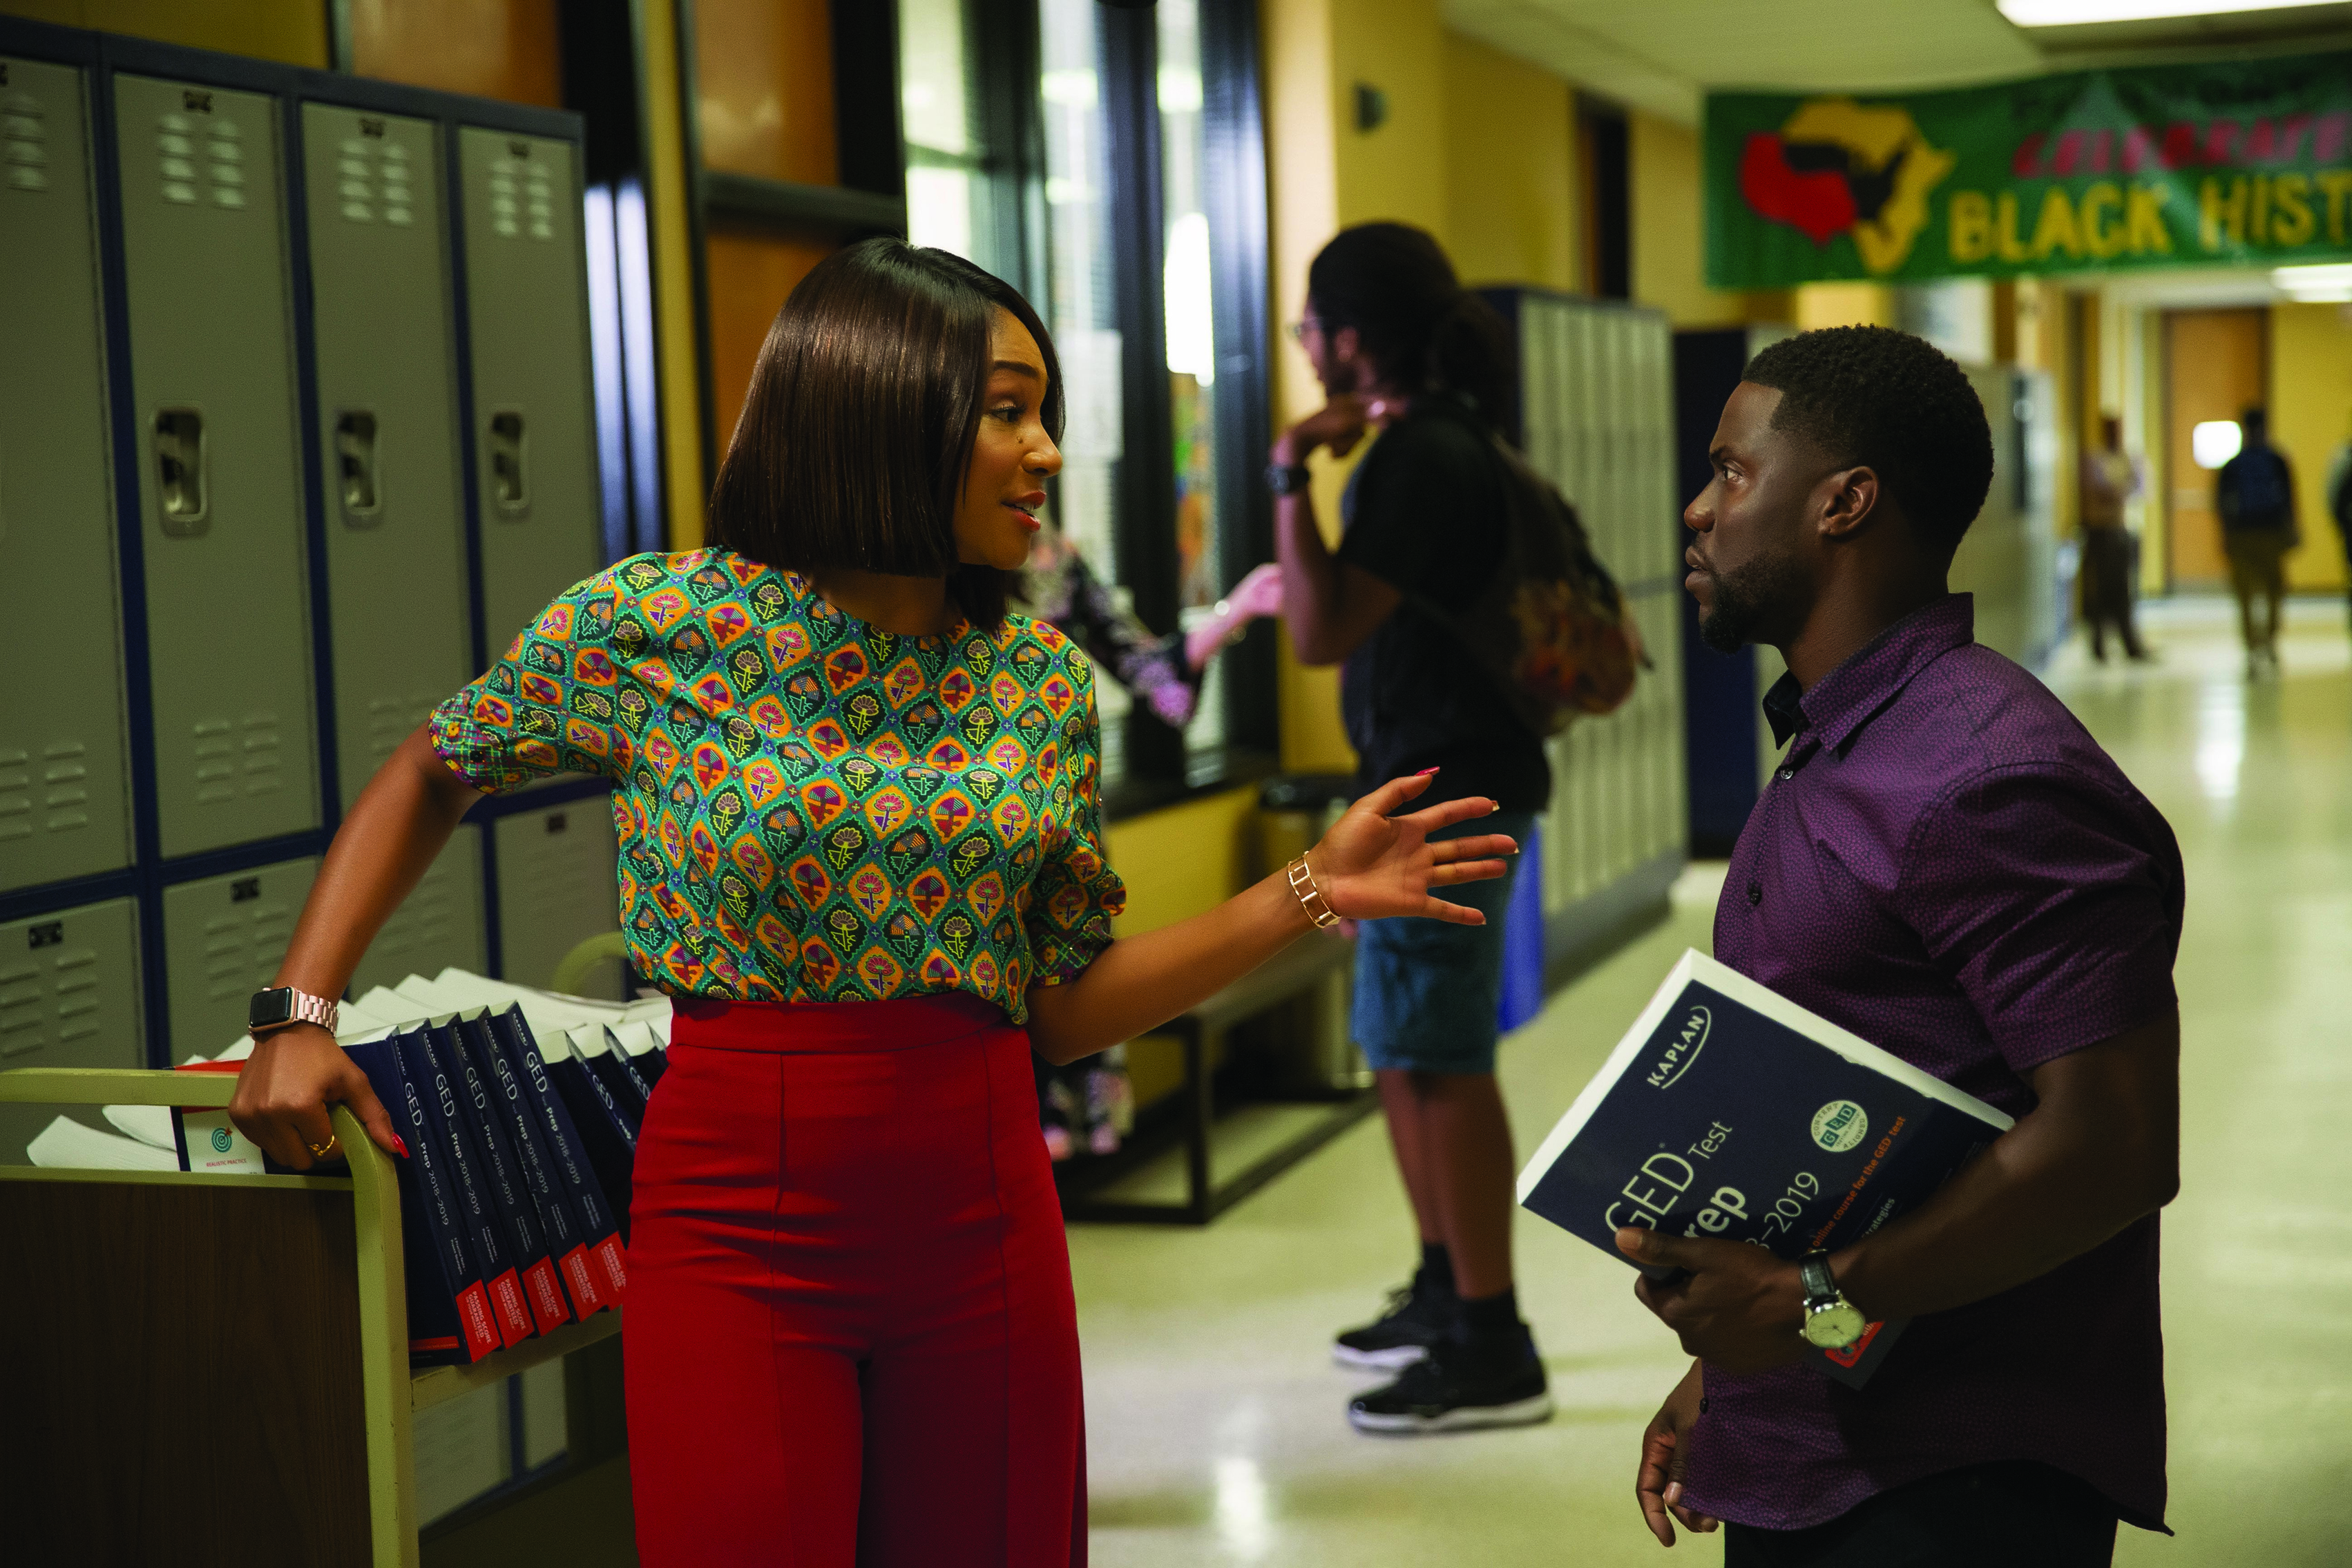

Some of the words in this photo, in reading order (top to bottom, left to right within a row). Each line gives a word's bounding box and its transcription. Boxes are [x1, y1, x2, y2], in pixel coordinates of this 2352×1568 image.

[1948, 181, 2176, 265] BLACK
[2198, 168, 2350, 254] HIST
[424, 1033, 437, 1065] KAPLAN
[454, 1026, 468, 1058] KAPLAN
[513, 1013, 527, 1044] KAPLAN
[1647, 1015, 1705, 1087] KAPLAN
[436, 1074, 455, 1117] GED
[451, 1132, 462, 1159] Prep
[466, 1067, 486, 1109] GED
[484, 1125, 495, 1151] Prep
[497, 1058, 517, 1100] GED
[516, 1115, 528, 1140] Prep
[526, 1051, 548, 1093] GED
[546, 1107, 558, 1132] Prep
[405, 1082, 423, 1126] GED
[419, 1142, 431, 1169] Prep
[1687, 1120, 1733, 1160] Test
[1813, 1102, 1838, 1137] CONTENT
[1822, 1107, 1854, 1145] GED
[1843, 1118, 1866, 1149] ALIGNED
[1813, 1221, 1836, 1247] online
[1833, 1189, 1858, 1221] course
[1852, 1175, 1867, 1190] for
[1863, 1158, 1879, 1176] the
[1888, 1115, 1906, 1137] test
[1683, 1186, 1749, 1238] rep
[468, 1293, 484, 1337] GUARANTEED
[471, 1290, 485, 1320] PASSING
[481, 1320, 492, 1344] SCORE
[499, 1281, 519, 1324] GUARANTEED
[504, 1278, 518, 1308] PASSING
[515, 1308, 526, 1330] SCORE
